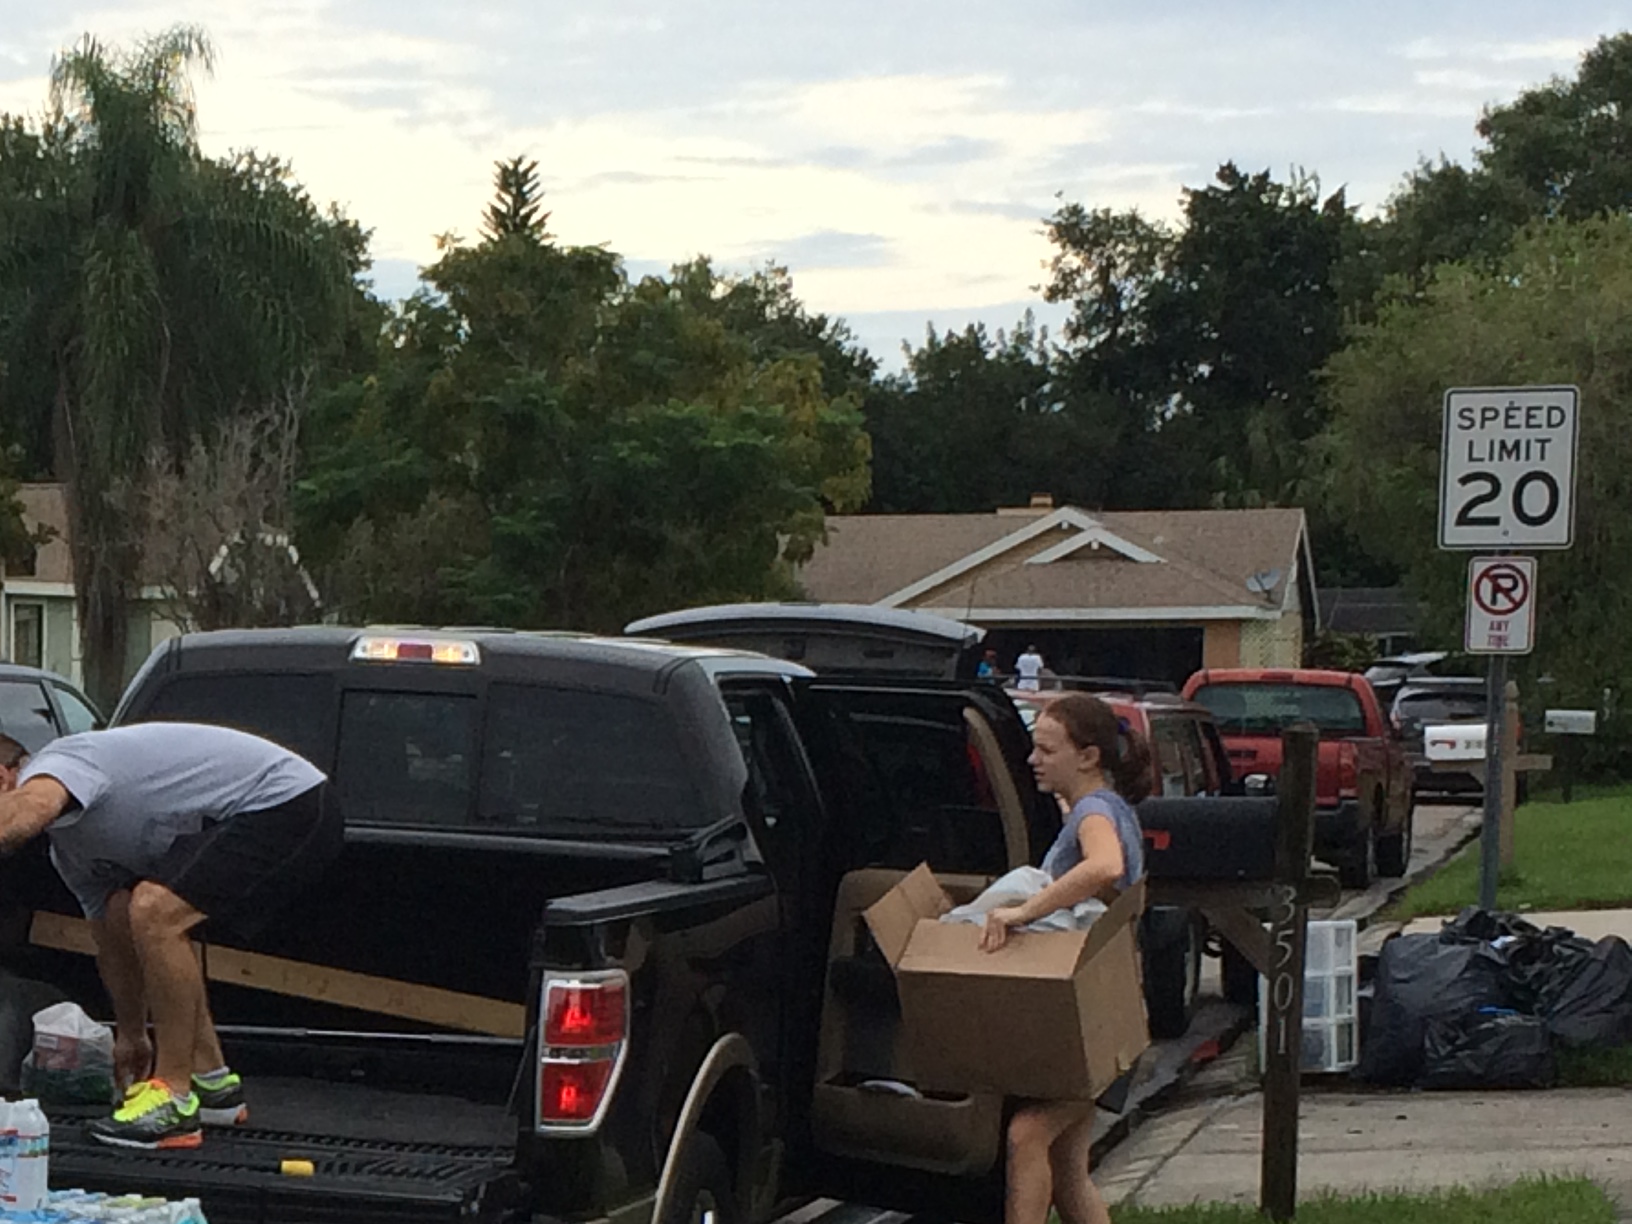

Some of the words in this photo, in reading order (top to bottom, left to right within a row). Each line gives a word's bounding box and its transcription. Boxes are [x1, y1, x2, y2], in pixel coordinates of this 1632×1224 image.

[1457, 405, 1567, 430] SPEED
[1467, 438, 1553, 463] LIMIT
[1454, 470, 1561, 528] 20
[1488, 620, 1510, 632] ANY
[1272, 884, 1298, 1056] 3501
